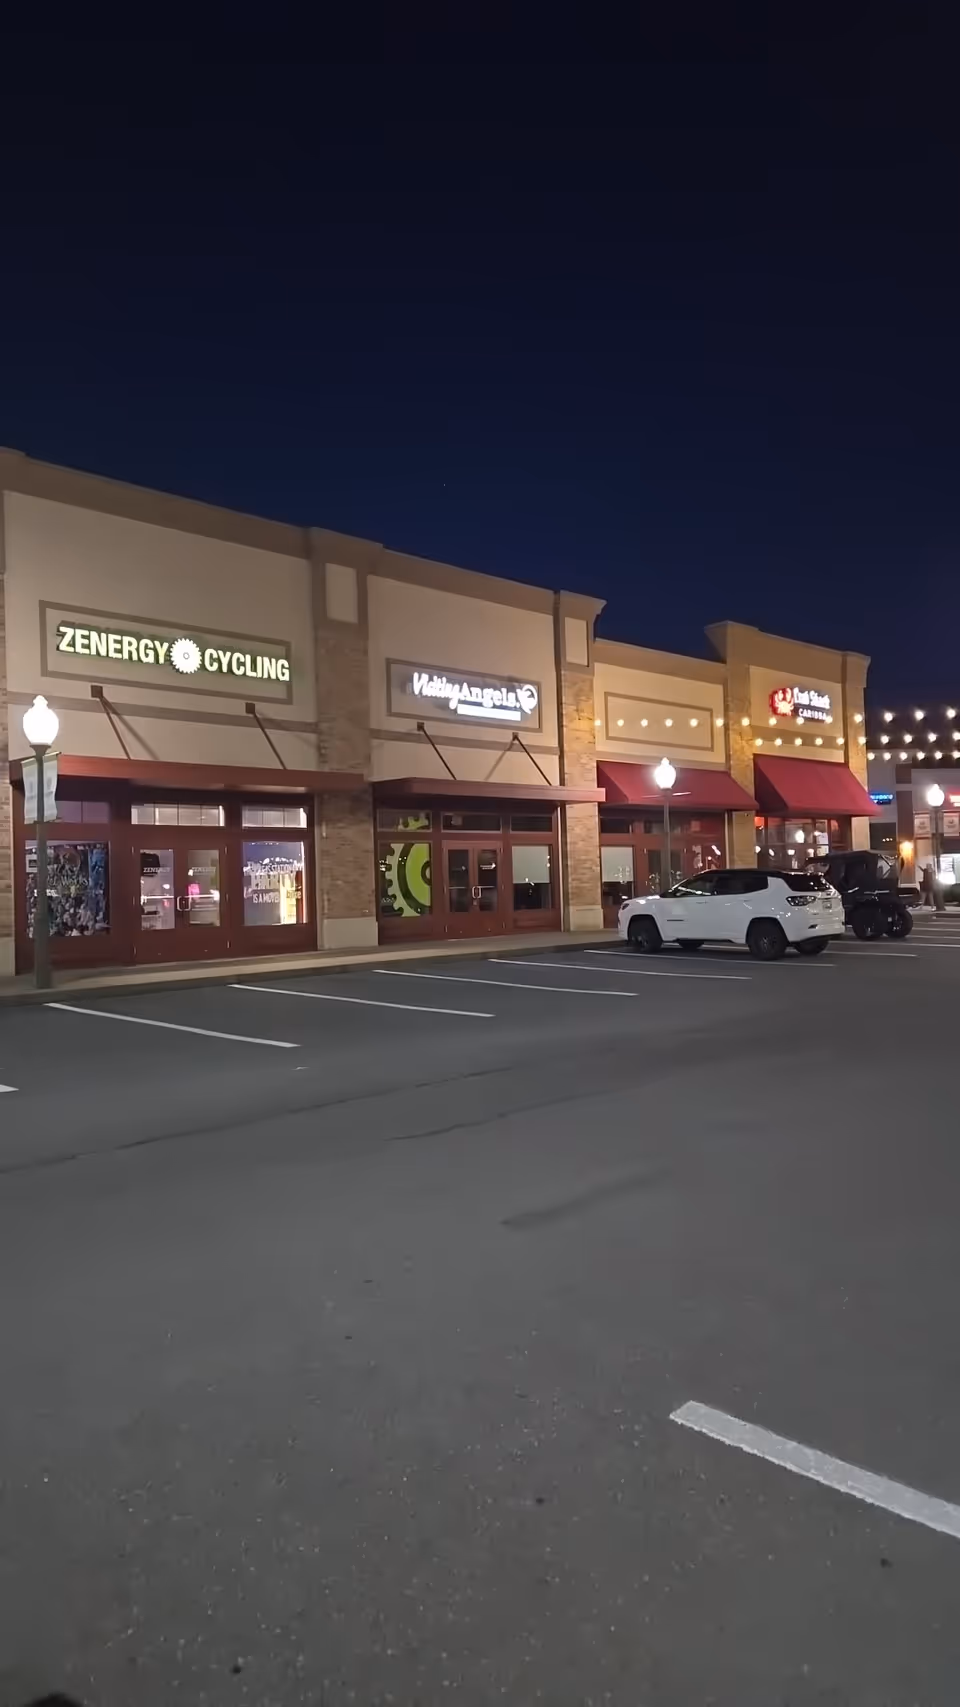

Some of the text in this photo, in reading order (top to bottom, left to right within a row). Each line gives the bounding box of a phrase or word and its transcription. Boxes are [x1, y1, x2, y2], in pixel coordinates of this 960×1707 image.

[58, 626, 291, 682] ZENERGY CYCLING
[413, 672, 460, 708] Visiting
